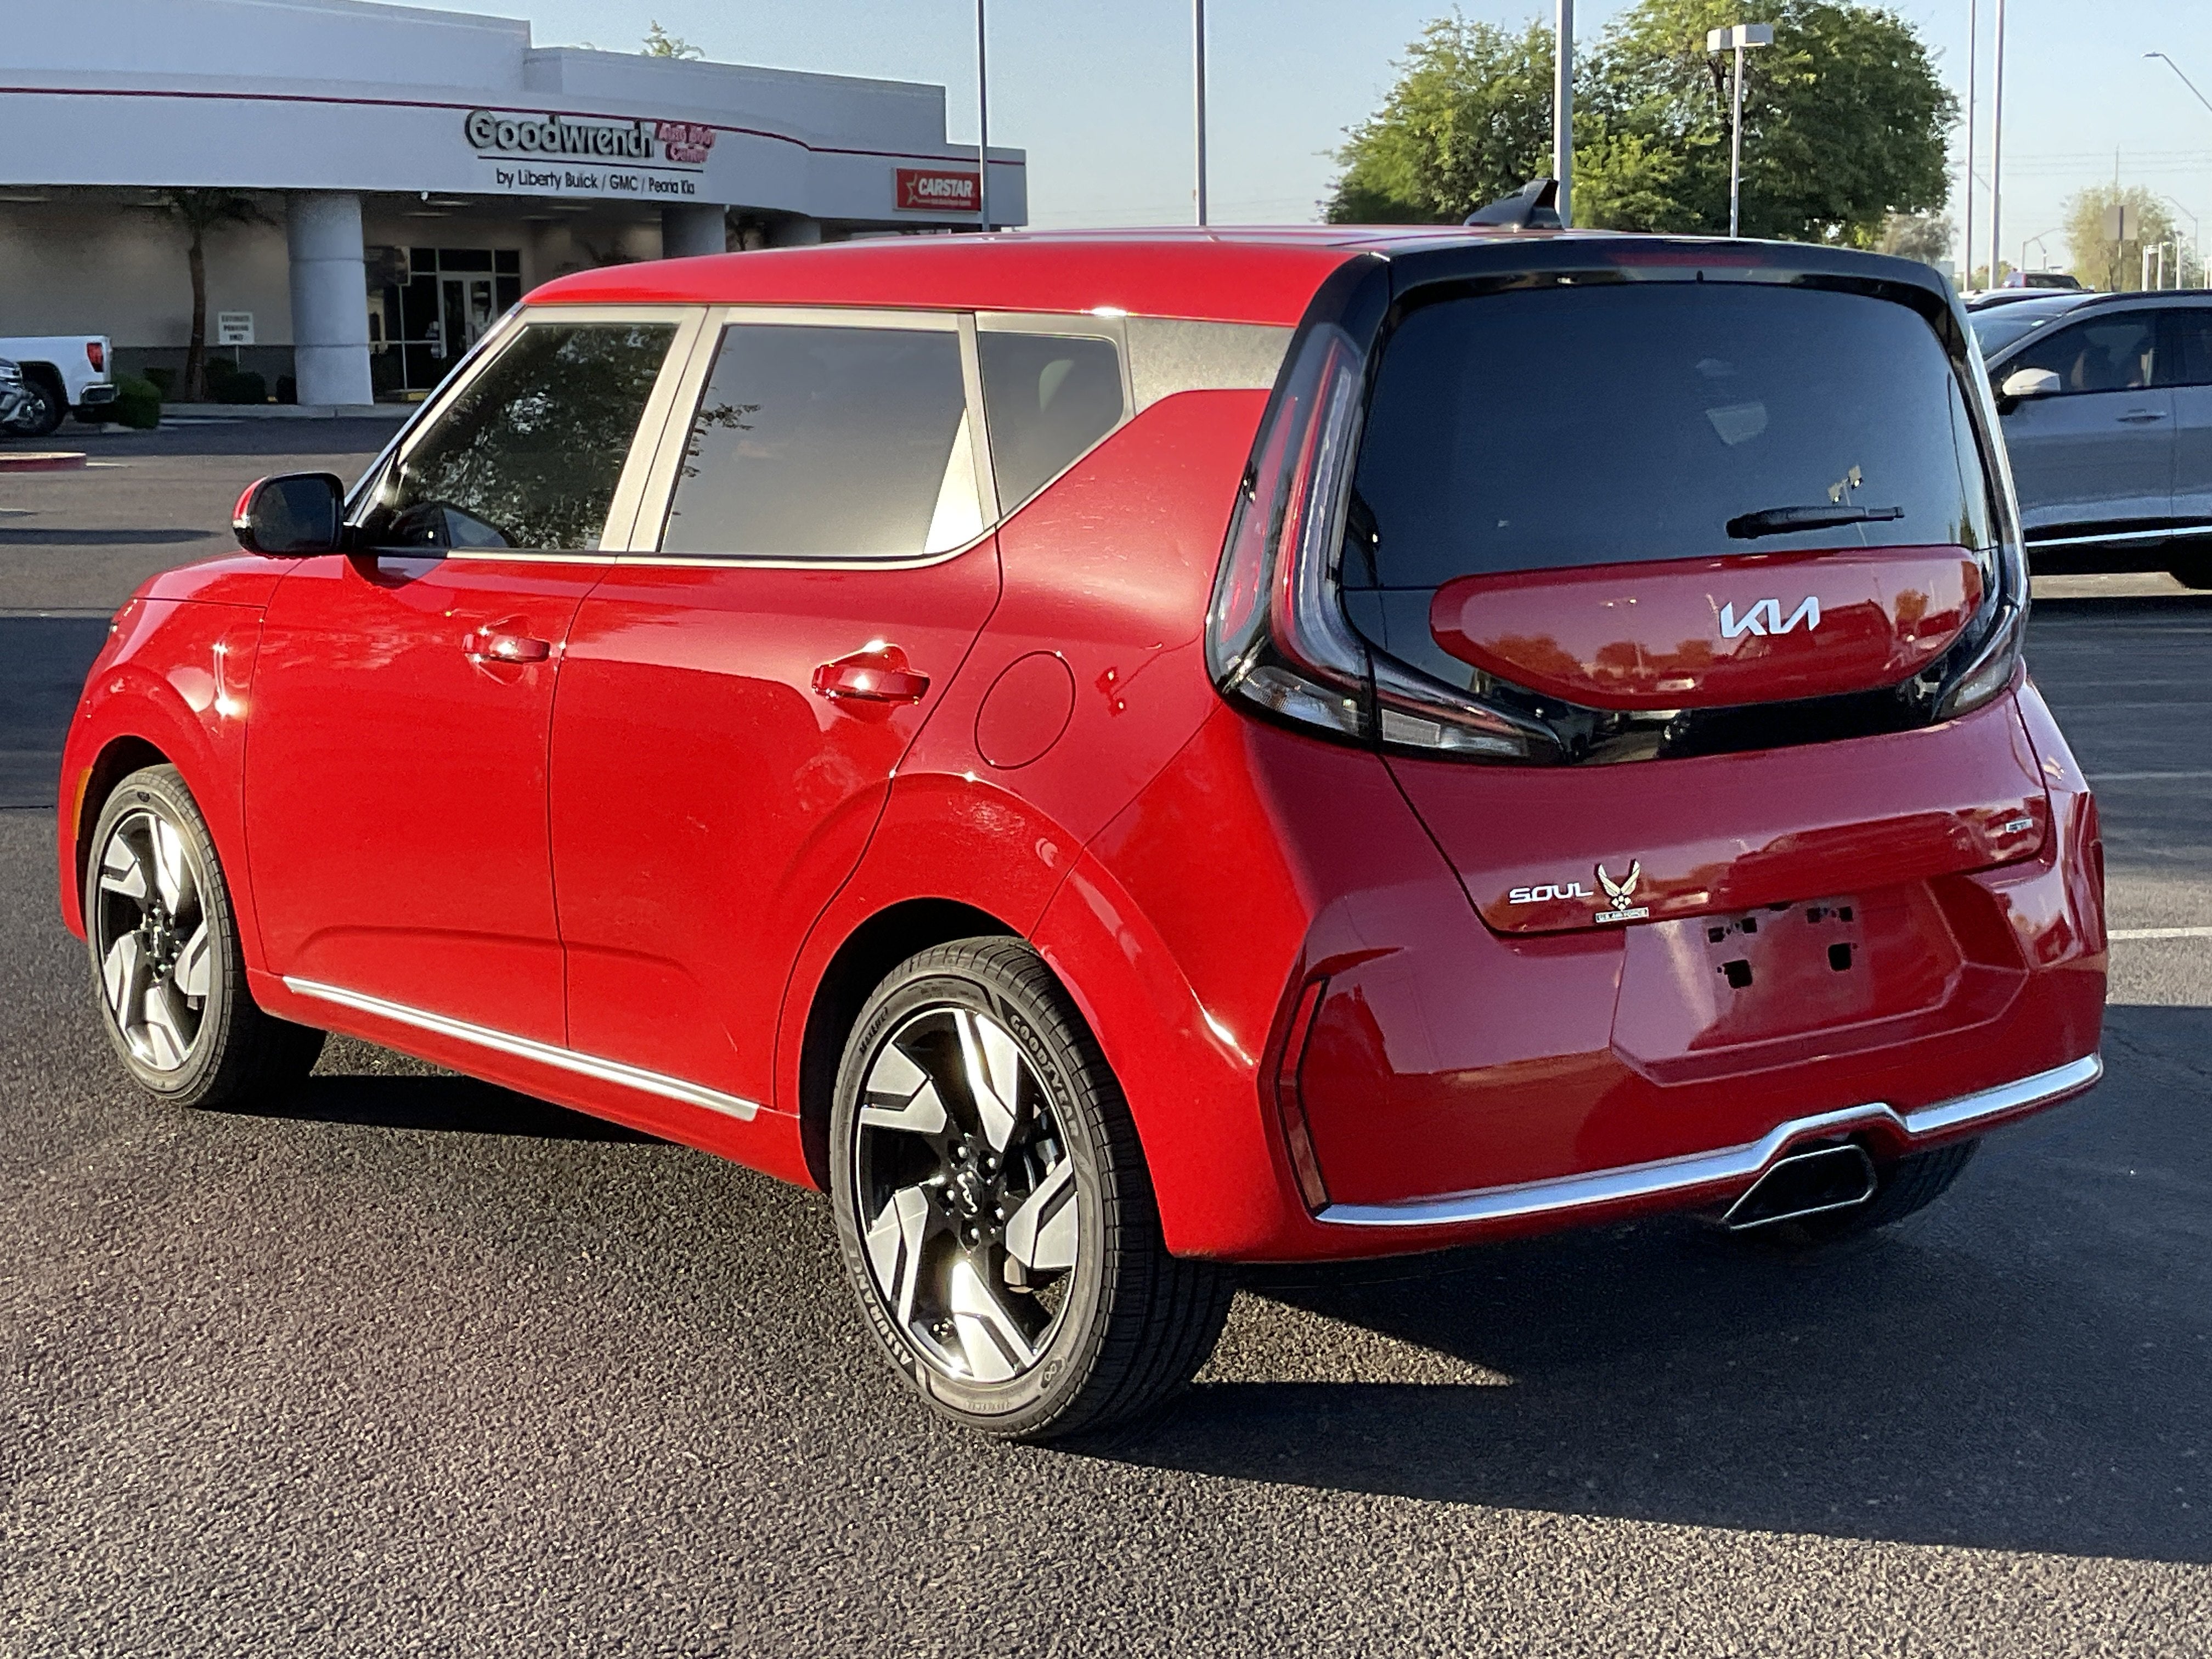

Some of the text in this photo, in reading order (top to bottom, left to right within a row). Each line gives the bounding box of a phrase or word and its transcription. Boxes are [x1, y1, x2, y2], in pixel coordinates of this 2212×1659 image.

[465, 110, 654, 157] Goodwrench
[496, 168, 514, 189] by
[518, 169, 561, 190] Liberty
[566, 172, 598, 188] Buick
[610, 174, 638, 190] GMC
[918, 178, 973, 197] CARSTAR
[1720, 596, 1820, 637] KIA
[1509, 882, 1594, 904] SOUL
[1010, 1014, 1079, 1136] GOODYEAR
